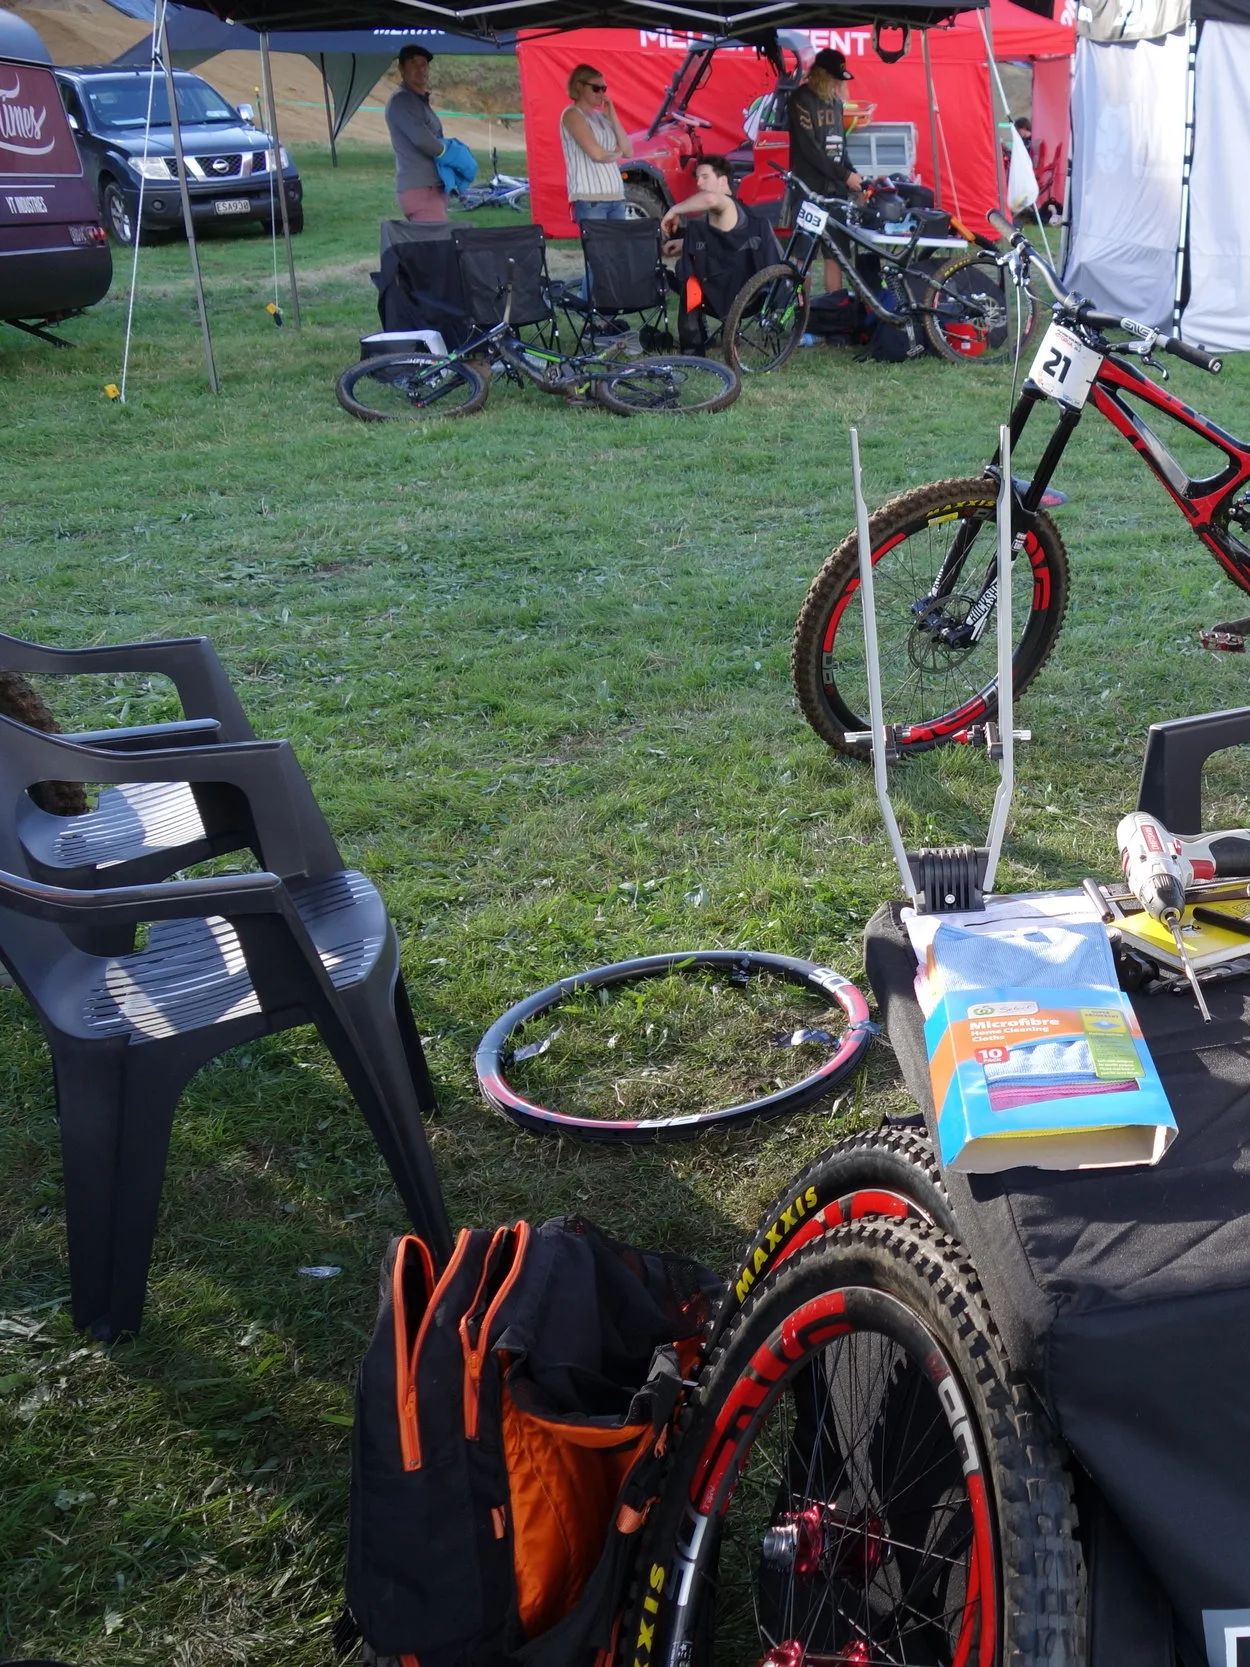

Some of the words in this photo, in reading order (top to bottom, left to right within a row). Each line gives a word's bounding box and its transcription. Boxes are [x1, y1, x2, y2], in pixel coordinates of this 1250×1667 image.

[1042, 346, 1072, 384] 21
[969, 1017, 1060, 1031] Microfibre
[971, 1029, 1003, 1037] Home
[1004, 1026, 1049, 1034] Cleaning
[972, 1034, 1005, 1042] Cloths
[978, 1049, 1003, 1059] 10
[735, 1185, 818, 1304] MAXXIS
